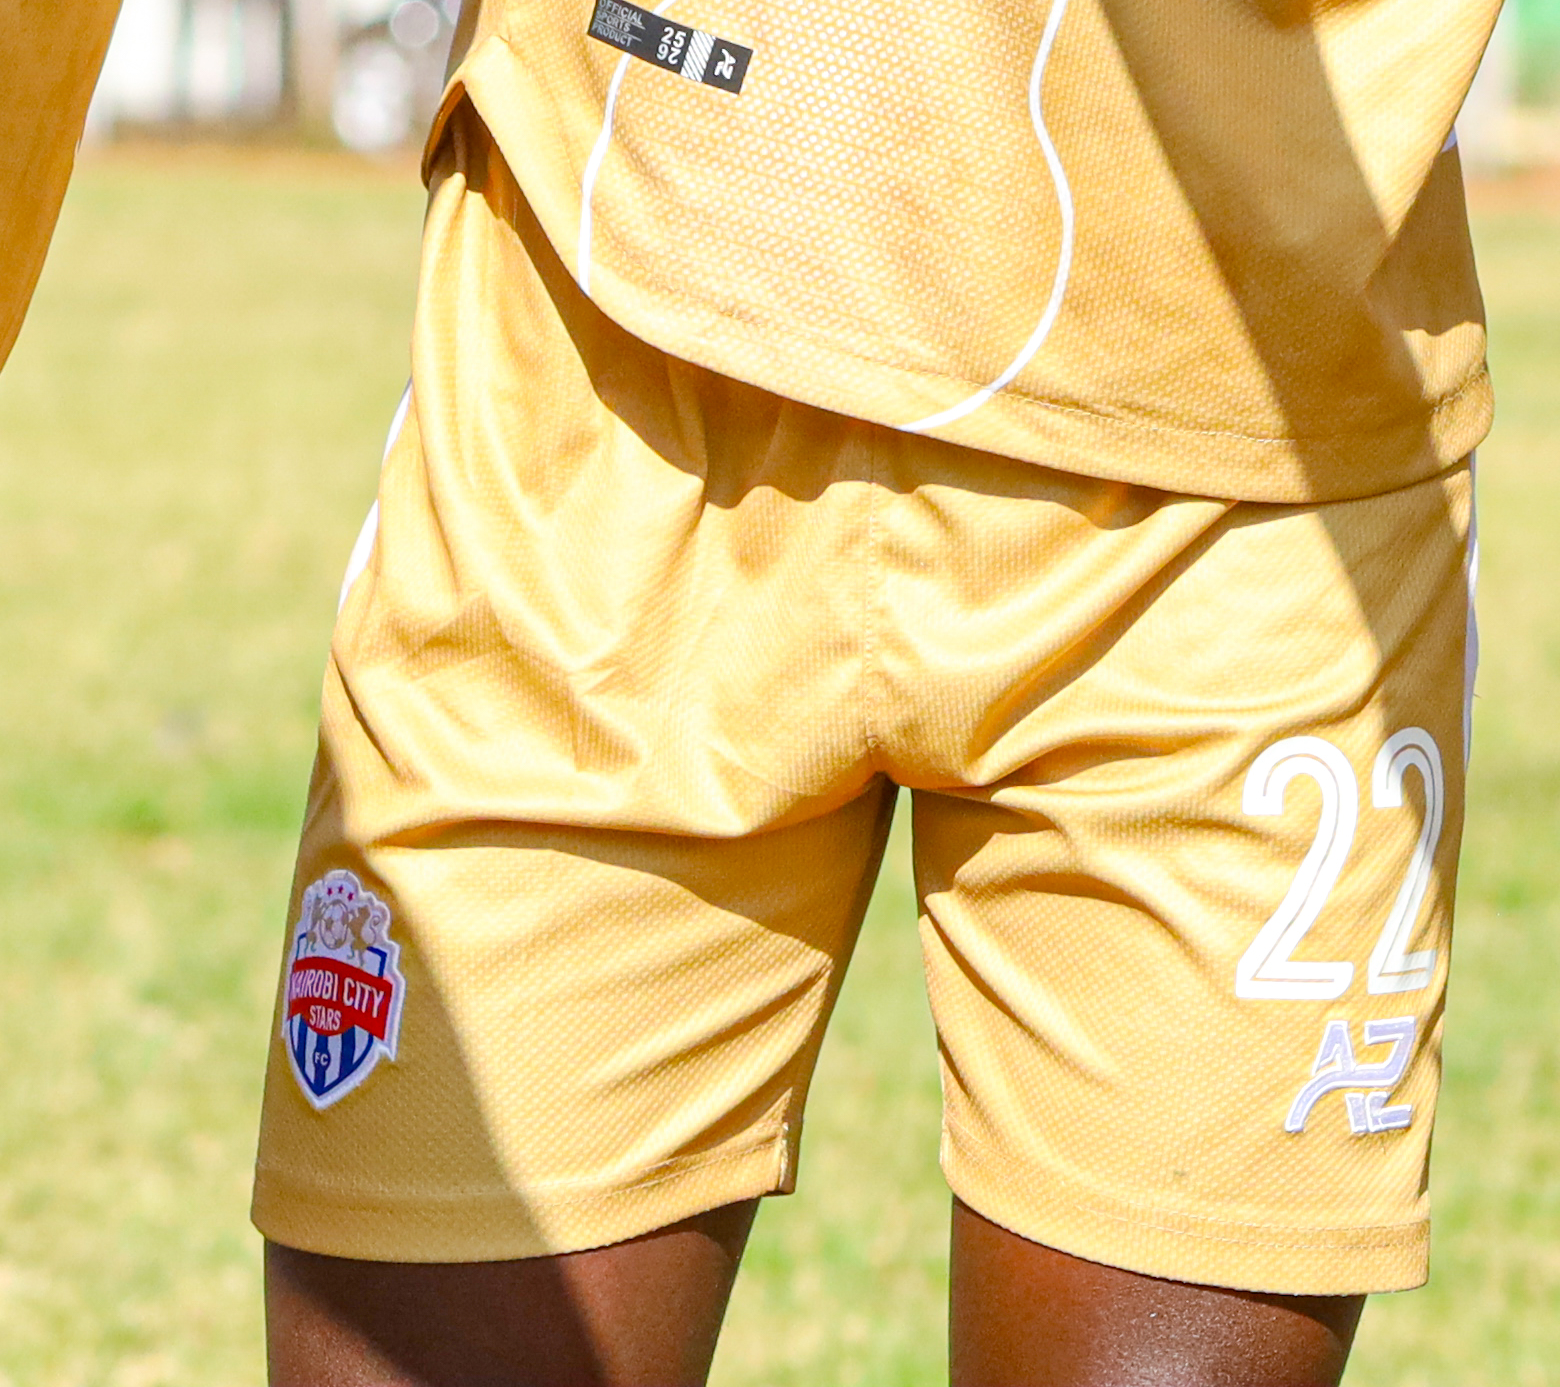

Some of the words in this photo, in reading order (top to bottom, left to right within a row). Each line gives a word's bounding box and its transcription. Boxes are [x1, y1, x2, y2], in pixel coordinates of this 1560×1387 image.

[595, 10, 632, 33] SPORTS
[591, 22, 633, 47] PRODUCT
[661, 27, 687, 48] 25
[1235, 727, 1444, 1000] 22
[343, 977, 385, 1019] CITY
[309, 1004, 342, 1031] STARS
[314, 1051, 329, 1066] FC
